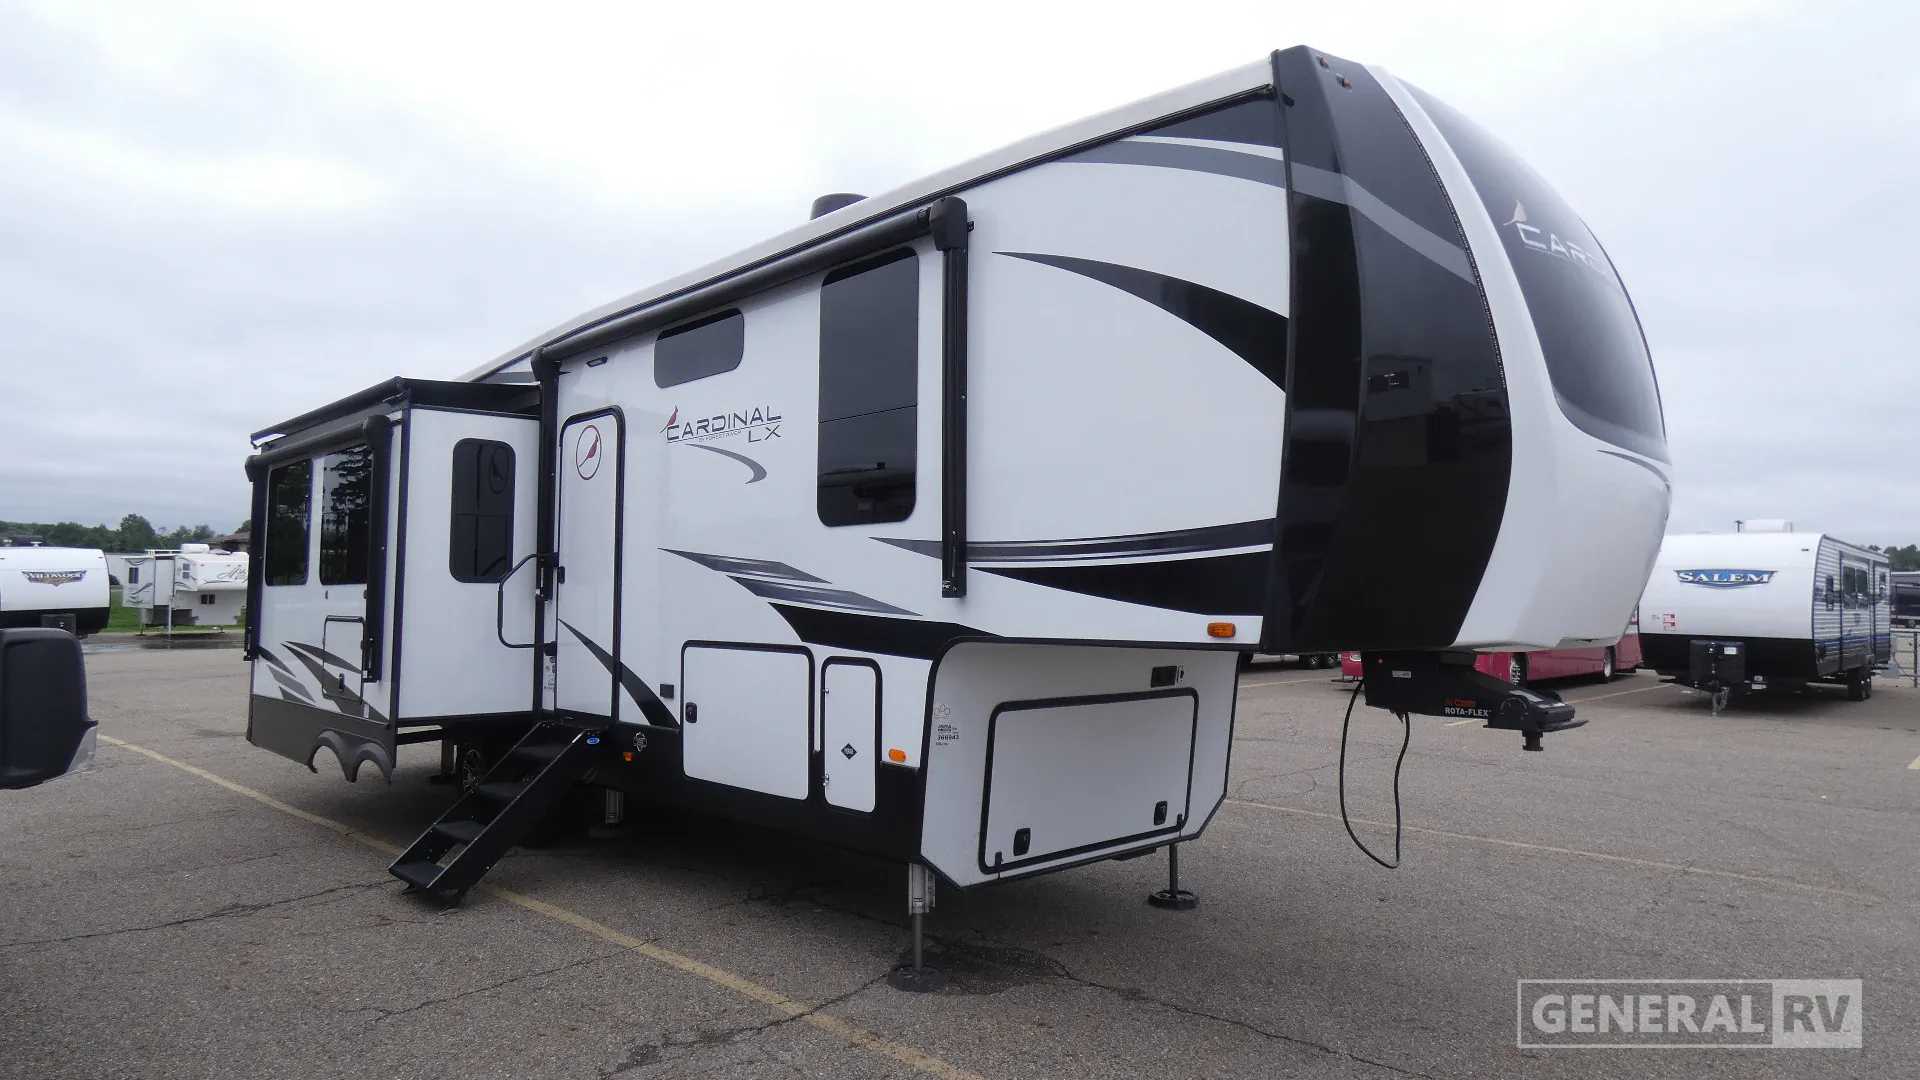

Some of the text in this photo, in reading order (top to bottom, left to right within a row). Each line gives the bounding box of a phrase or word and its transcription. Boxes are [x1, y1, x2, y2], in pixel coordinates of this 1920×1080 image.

[666, 405, 782, 441] CARDINAL
[748, 424, 782, 443] LX
[1678, 571, 1771, 583] SALEM
